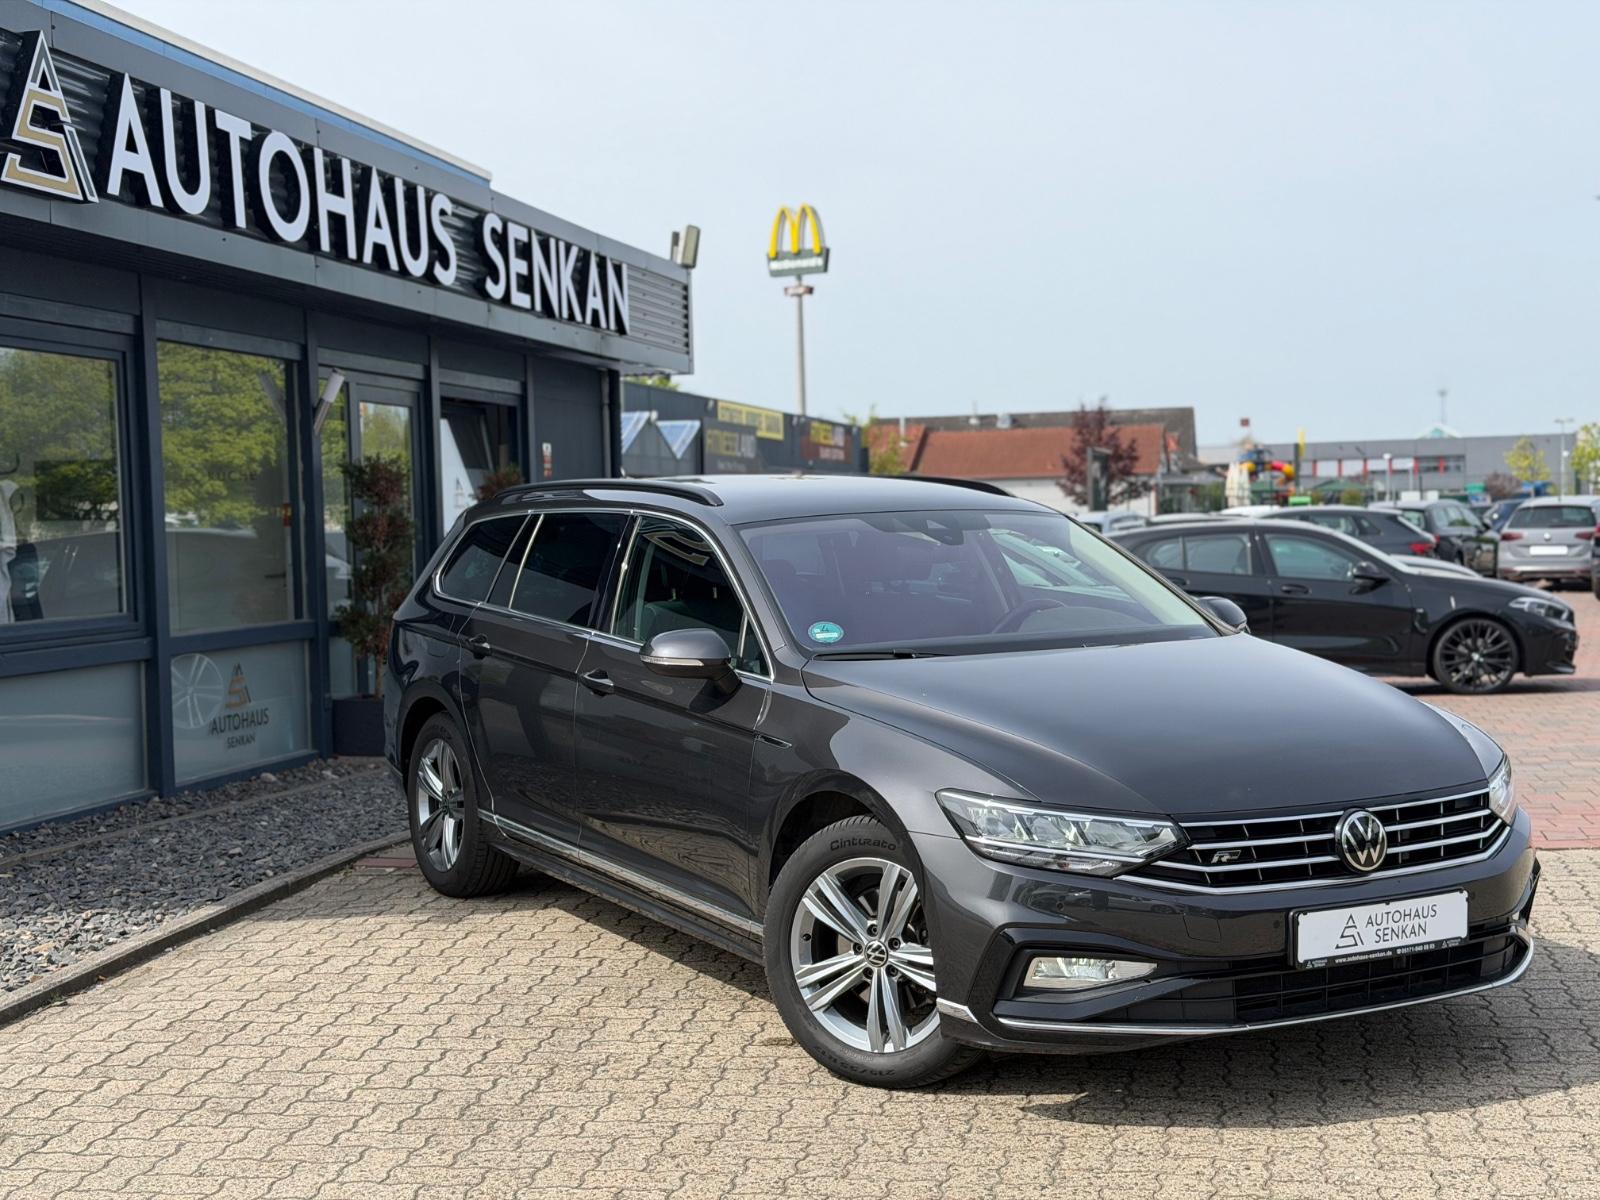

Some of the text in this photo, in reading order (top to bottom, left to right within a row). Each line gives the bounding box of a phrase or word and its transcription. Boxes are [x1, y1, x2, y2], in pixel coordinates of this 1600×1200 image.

[106, 72, 631, 335] AUTOHAUS SENKAN
[210, 708, 270, 735] AUTOHAUS
[226, 732, 256, 749] SENKAN
[1365, 904, 1437, 928] AUTOHAUS
[1374, 921, 1428, 944] SENKAN
